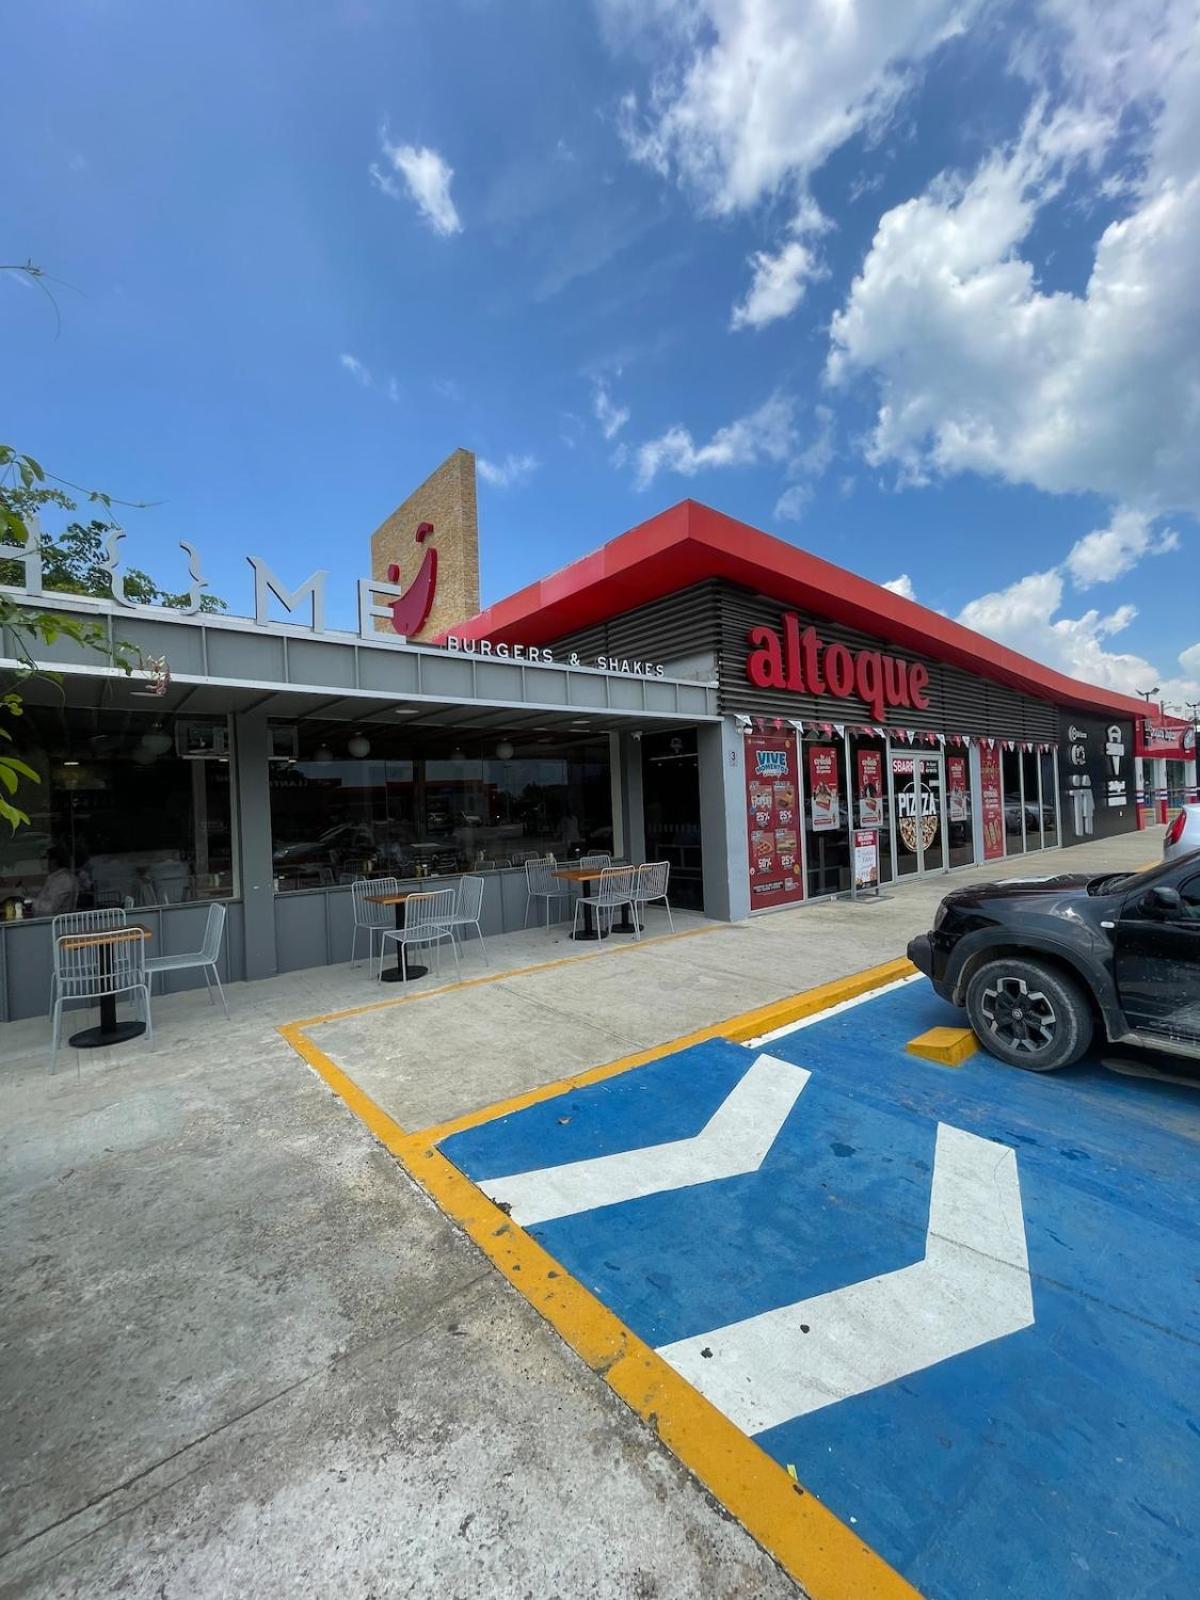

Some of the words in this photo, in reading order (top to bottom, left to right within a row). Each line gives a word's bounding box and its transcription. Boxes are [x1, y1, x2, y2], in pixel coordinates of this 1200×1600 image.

[447, 636, 553, 663] BURGERS
[569, 652, 581, 667] &
[598, 656, 665, 677] SHAKES
[747, 611, 930, 723] altoque
[756, 751, 787, 766] VIVE
[898, 793, 937, 817] PIZZA
